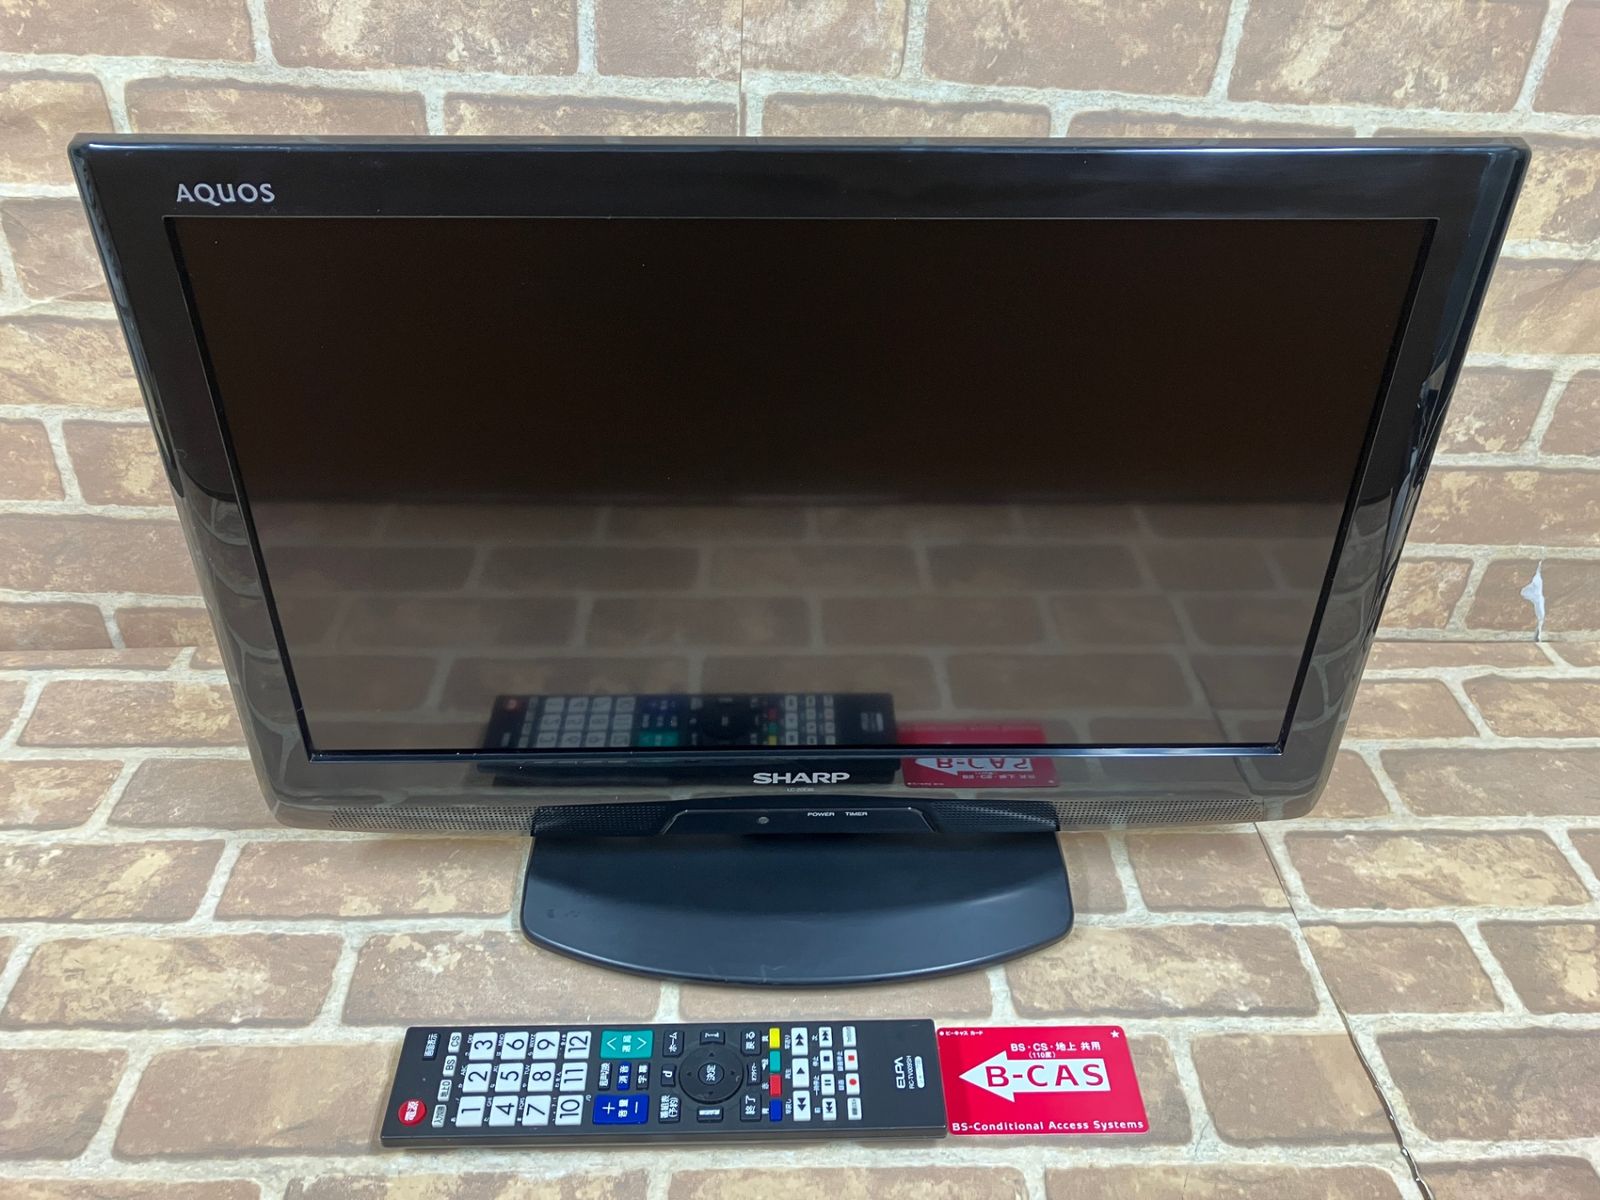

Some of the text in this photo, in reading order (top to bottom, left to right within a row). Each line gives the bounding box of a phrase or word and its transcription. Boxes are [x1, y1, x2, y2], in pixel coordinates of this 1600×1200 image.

[176, 183, 275, 206] AQUOS
[753, 772, 850, 784] SHARP
[451, 1035, 460, 1047] CS
[474, 1040, 493, 1050] 3
[506, 1039, 525, 1050] 6
[537, 1039, 555, 1050] 9
[568, 1035, 588, 1053] 12
[669, 1032, 678, 1052] ホーム
[746, 1032, 755, 1050] 戻る
[1080, 1042, 1101, 1050] 共用
[446, 1059, 455, 1070] BS
[706, 1064, 716, 1081] 決定
[894, 1056, 906, 1088] ELPA
[468, 1071, 488, 1082] 2
[500, 1070, 519, 1081] 5
[532, 1070, 551, 1081] 8
[564, 1068, 584, 1084] 11
[619, 1064, 629, 1084] 消音
[638, 1064, 648, 1084] 字幕
[985, 1064, 1104, 1087] B-CAS
[496, 1103, 515, 1115] 4
[526, 1103, 545, 1116] 7
[560, 1099, 580, 1119] 10
[618, 1099, 629, 1118] 音量
[660, 1095, 670, 1118] 番組表
[746, 1095, 756, 1115] 終了
[952, 1120, 1144, 1131] BS-Conditional Access Systems
